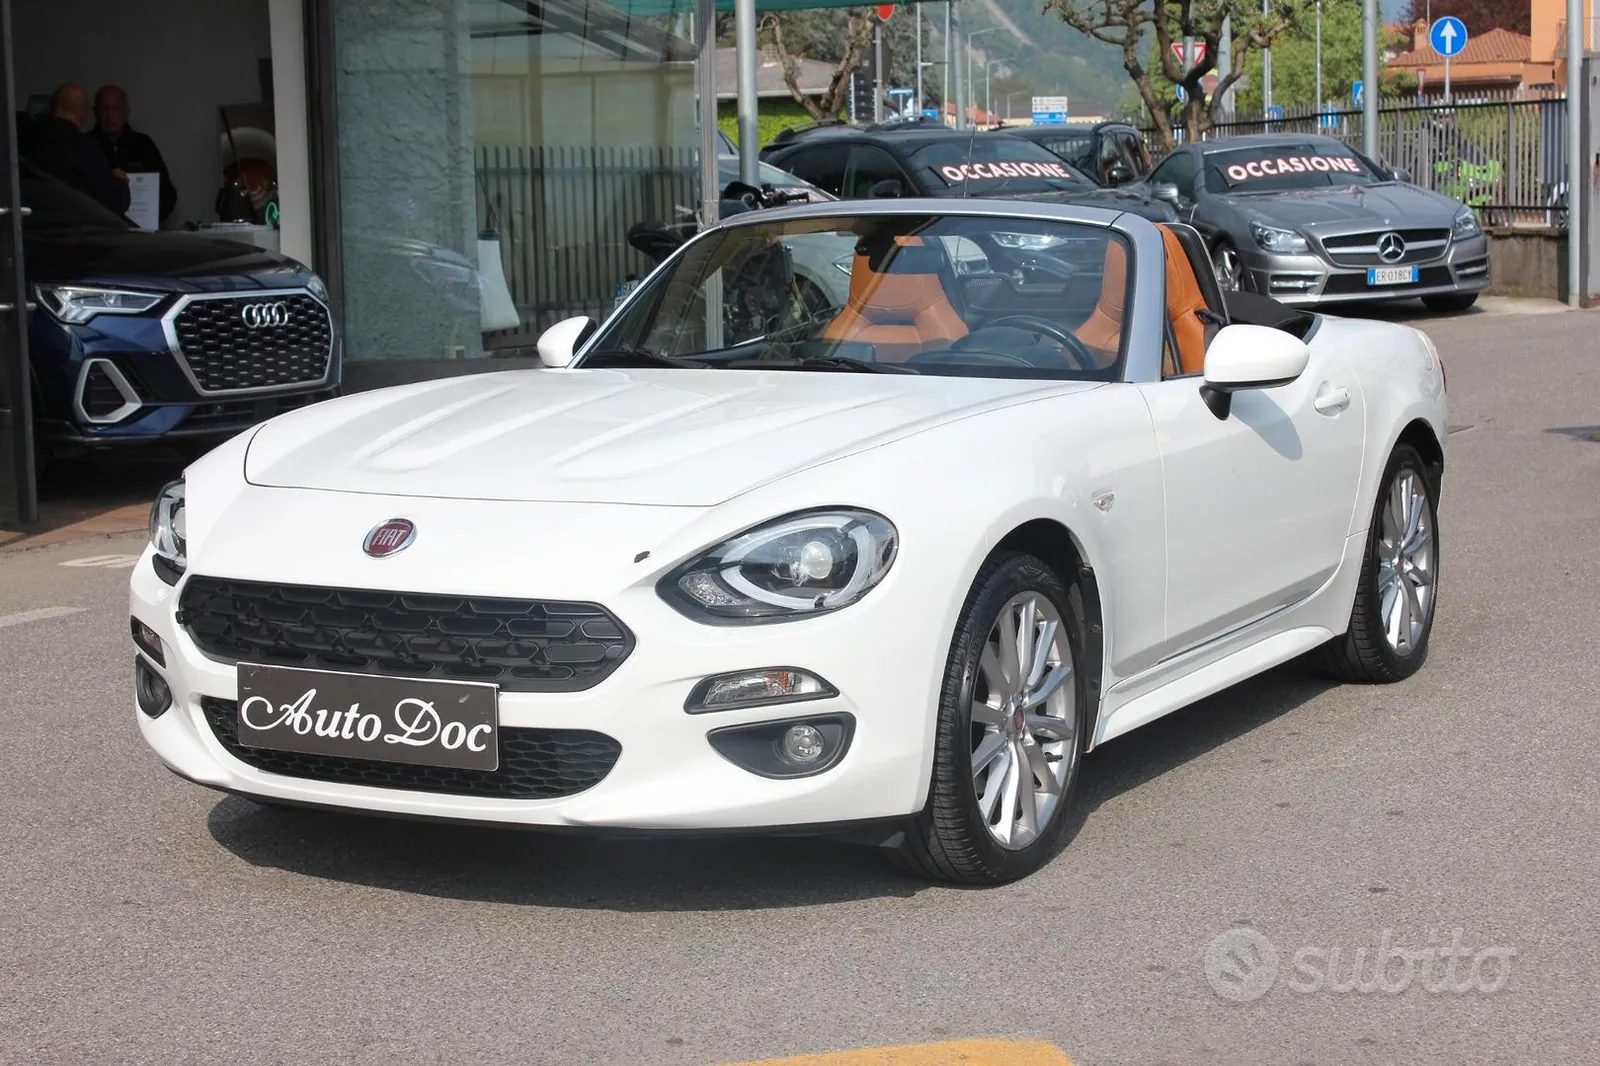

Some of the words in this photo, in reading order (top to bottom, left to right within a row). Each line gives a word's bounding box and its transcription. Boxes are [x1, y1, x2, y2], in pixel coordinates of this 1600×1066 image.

[942, 162, 1071, 181] OCCASIONE
[1228, 156, 1360, 180] OCCASIONE
[372, 528, 407, 547] FIAT
[241, 688, 382, 742] Auto
[383, 698, 492, 752] Doc
